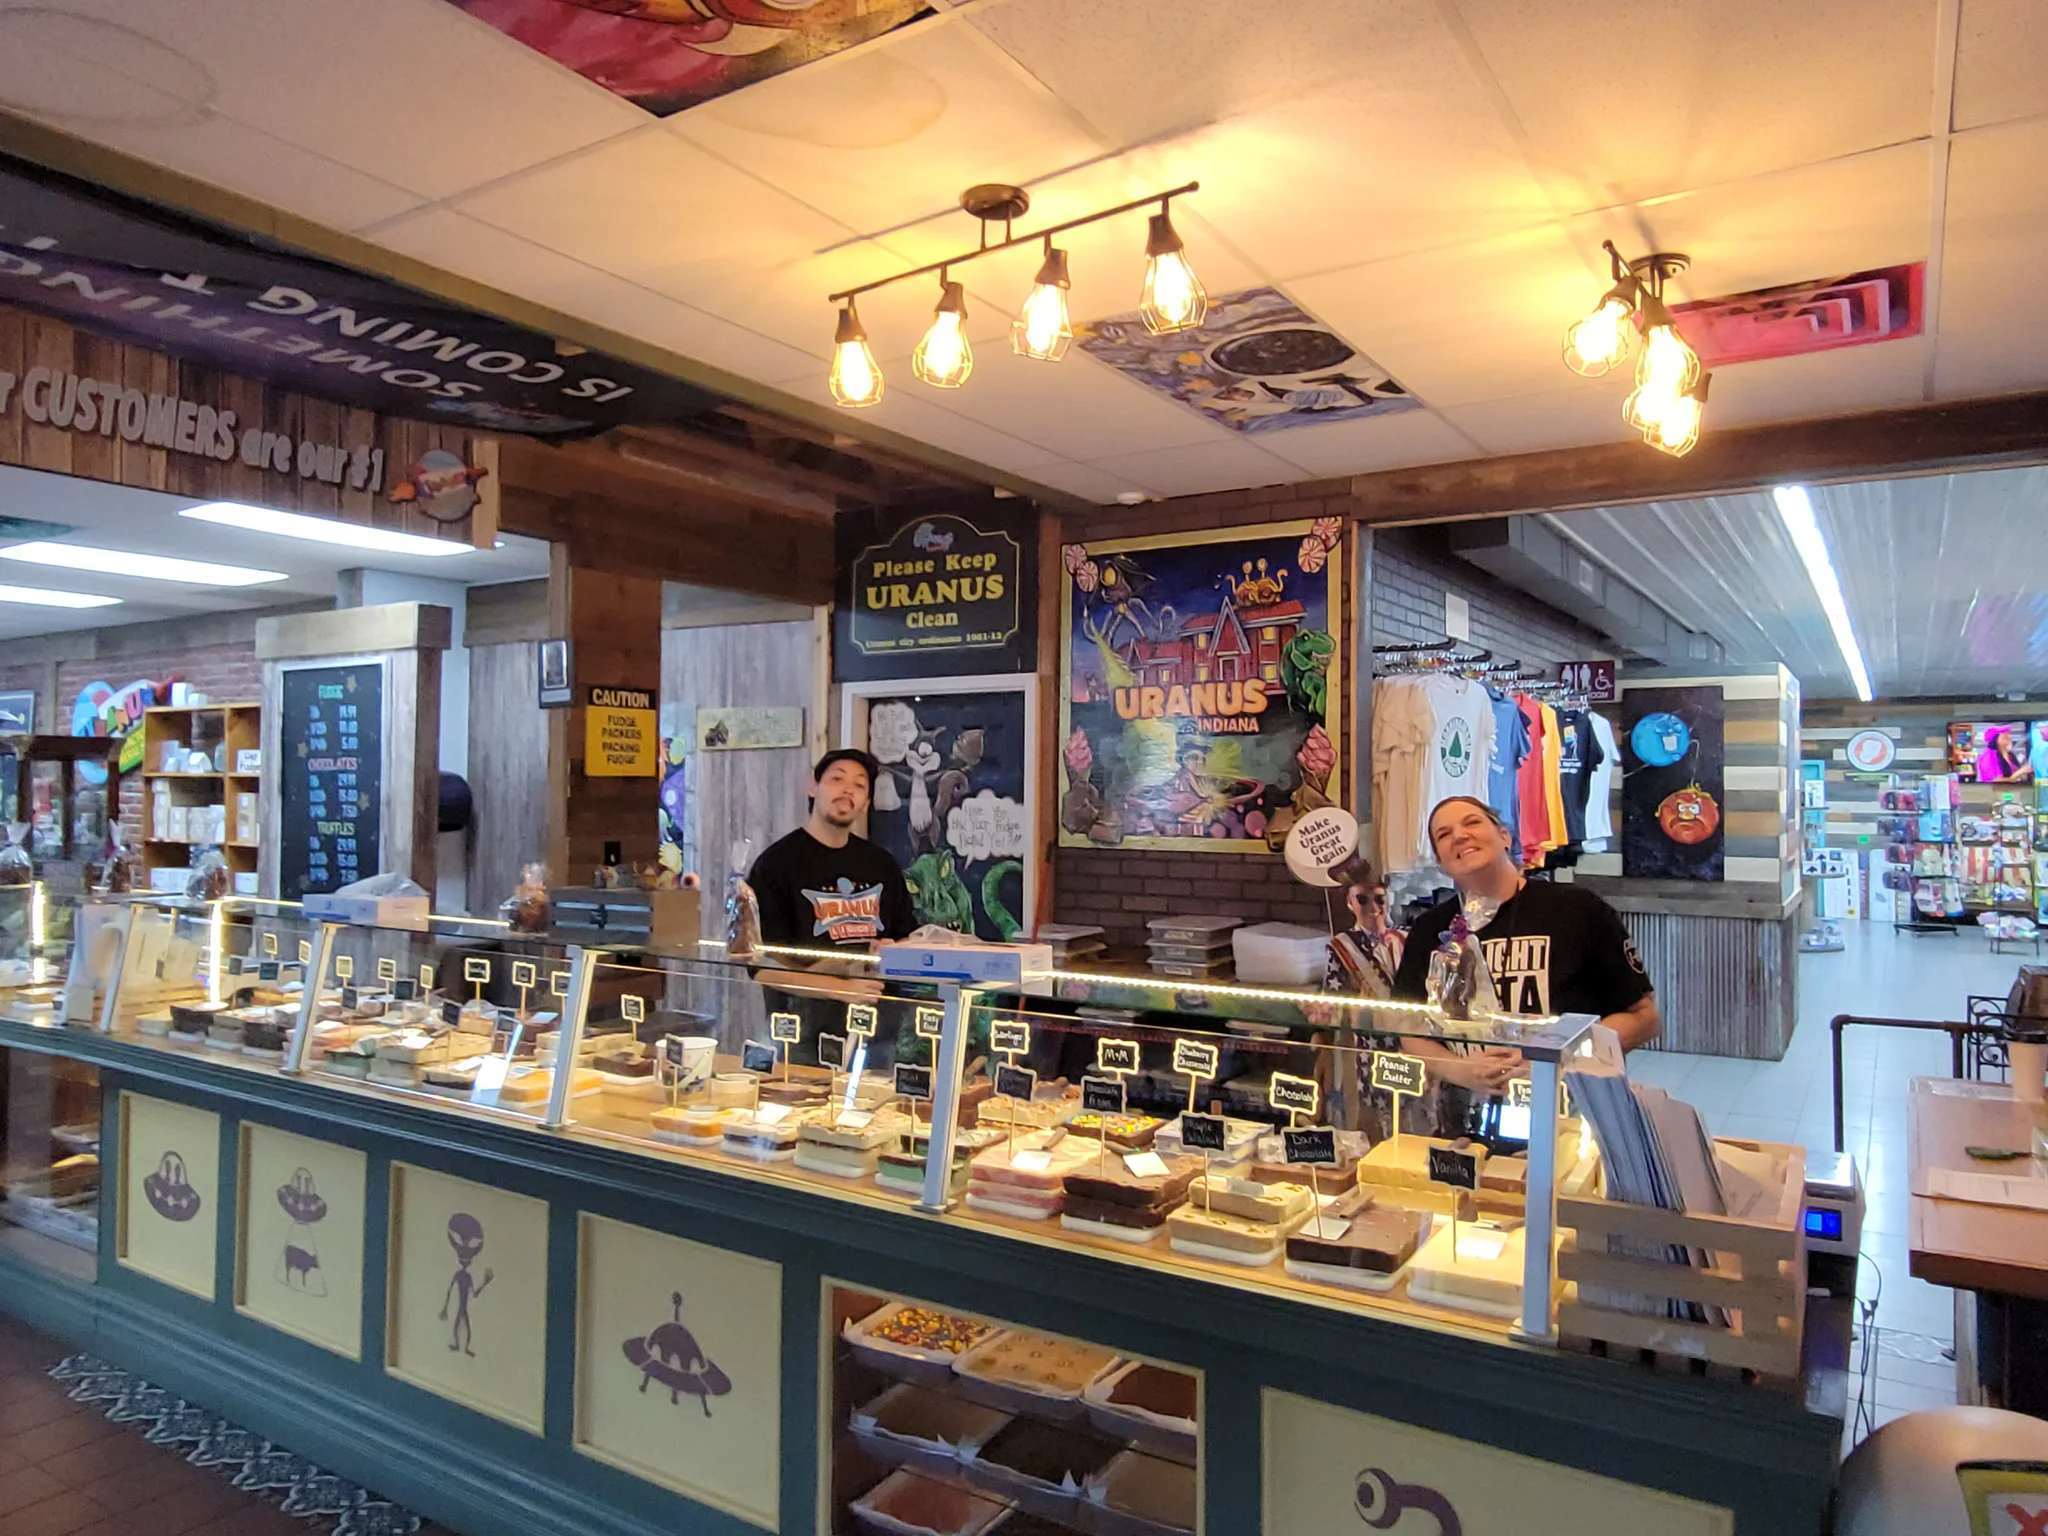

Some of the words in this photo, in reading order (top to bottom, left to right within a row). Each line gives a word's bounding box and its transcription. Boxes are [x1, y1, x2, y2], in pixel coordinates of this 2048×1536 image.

[247, 284, 565, 384] COMING
[562, 377, 636, 404] IS
[23, 366, 238, 461] CUSTOMERS
[240, 428, 292, 474] are
[298, 441, 348, 484] our
[872, 557, 935, 579] Please
[945, 551, 998, 572] Keep
[866, 573, 1005, 611] URANUS
[906, 611, 959, 630] Clean
[592, 687, 650, 708] CAUTION
[1114, 678, 1270, 720] URANUS
[1199, 716, 1260, 734] INDIANA
[1298, 817, 1331, 838] Make
[1299, 824, 1341, 849] Uranus
[1310, 835, 1342, 855] Great
[1315, 845, 1348, 866] Again
[1379, 1055, 1410, 1074] Peanut
[1382, 1069, 1413, 1086] Butter
